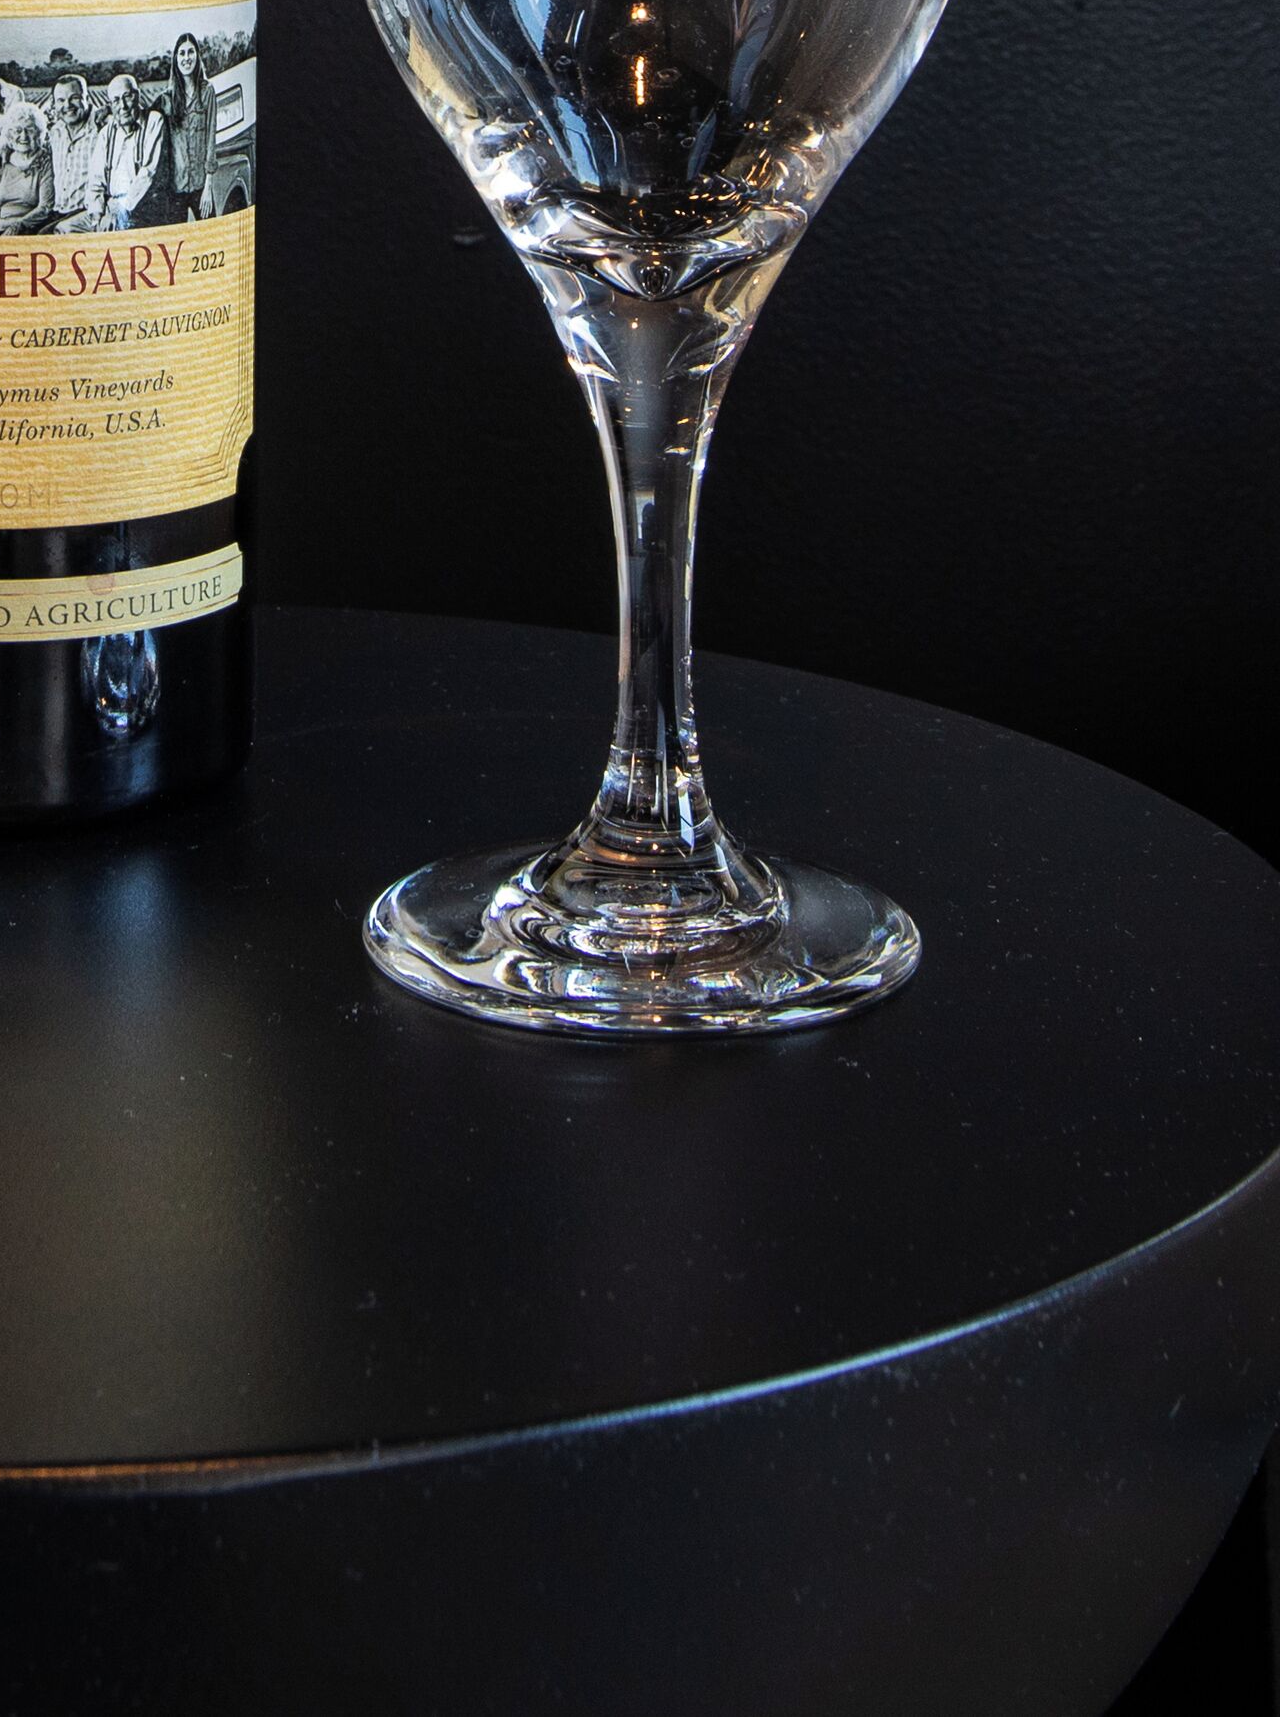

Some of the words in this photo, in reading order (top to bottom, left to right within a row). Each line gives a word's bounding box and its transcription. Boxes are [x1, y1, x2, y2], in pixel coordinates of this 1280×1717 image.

[191, 250, 226, 274] 2022
[10, 321, 134, 349] CABERNET
[136, 304, 232, 339] SAUVIGNON
[70, 369, 174, 402] Vineyards
[105, 408, 167, 436] U.S.A.
[25, 574, 223, 628] AGRICULTURE
